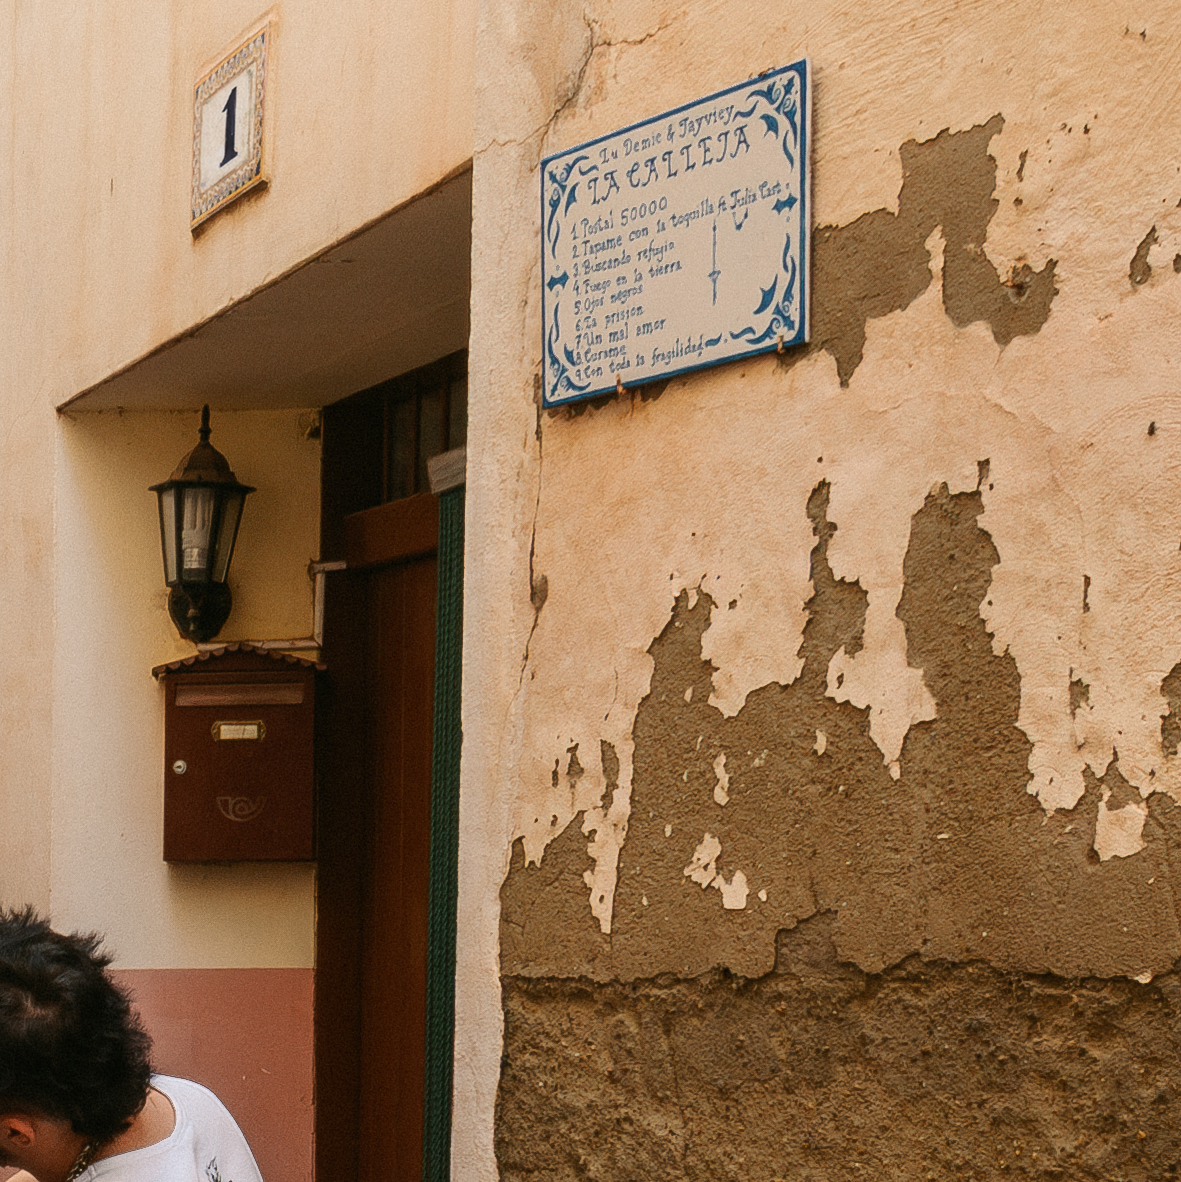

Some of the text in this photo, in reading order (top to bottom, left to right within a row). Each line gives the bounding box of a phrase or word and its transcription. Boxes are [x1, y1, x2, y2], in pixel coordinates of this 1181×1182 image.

[219, 86, 238, 168] 1
[599, 148, 619, 165] Lu
[623, 132, 662, 157] Demie
[678, 104, 736, 139] Jayviey
[587, 124, 750, 206] LA CALLEJA
[620, 195, 668, 228] 50000
[628, 226, 649, 243] con
